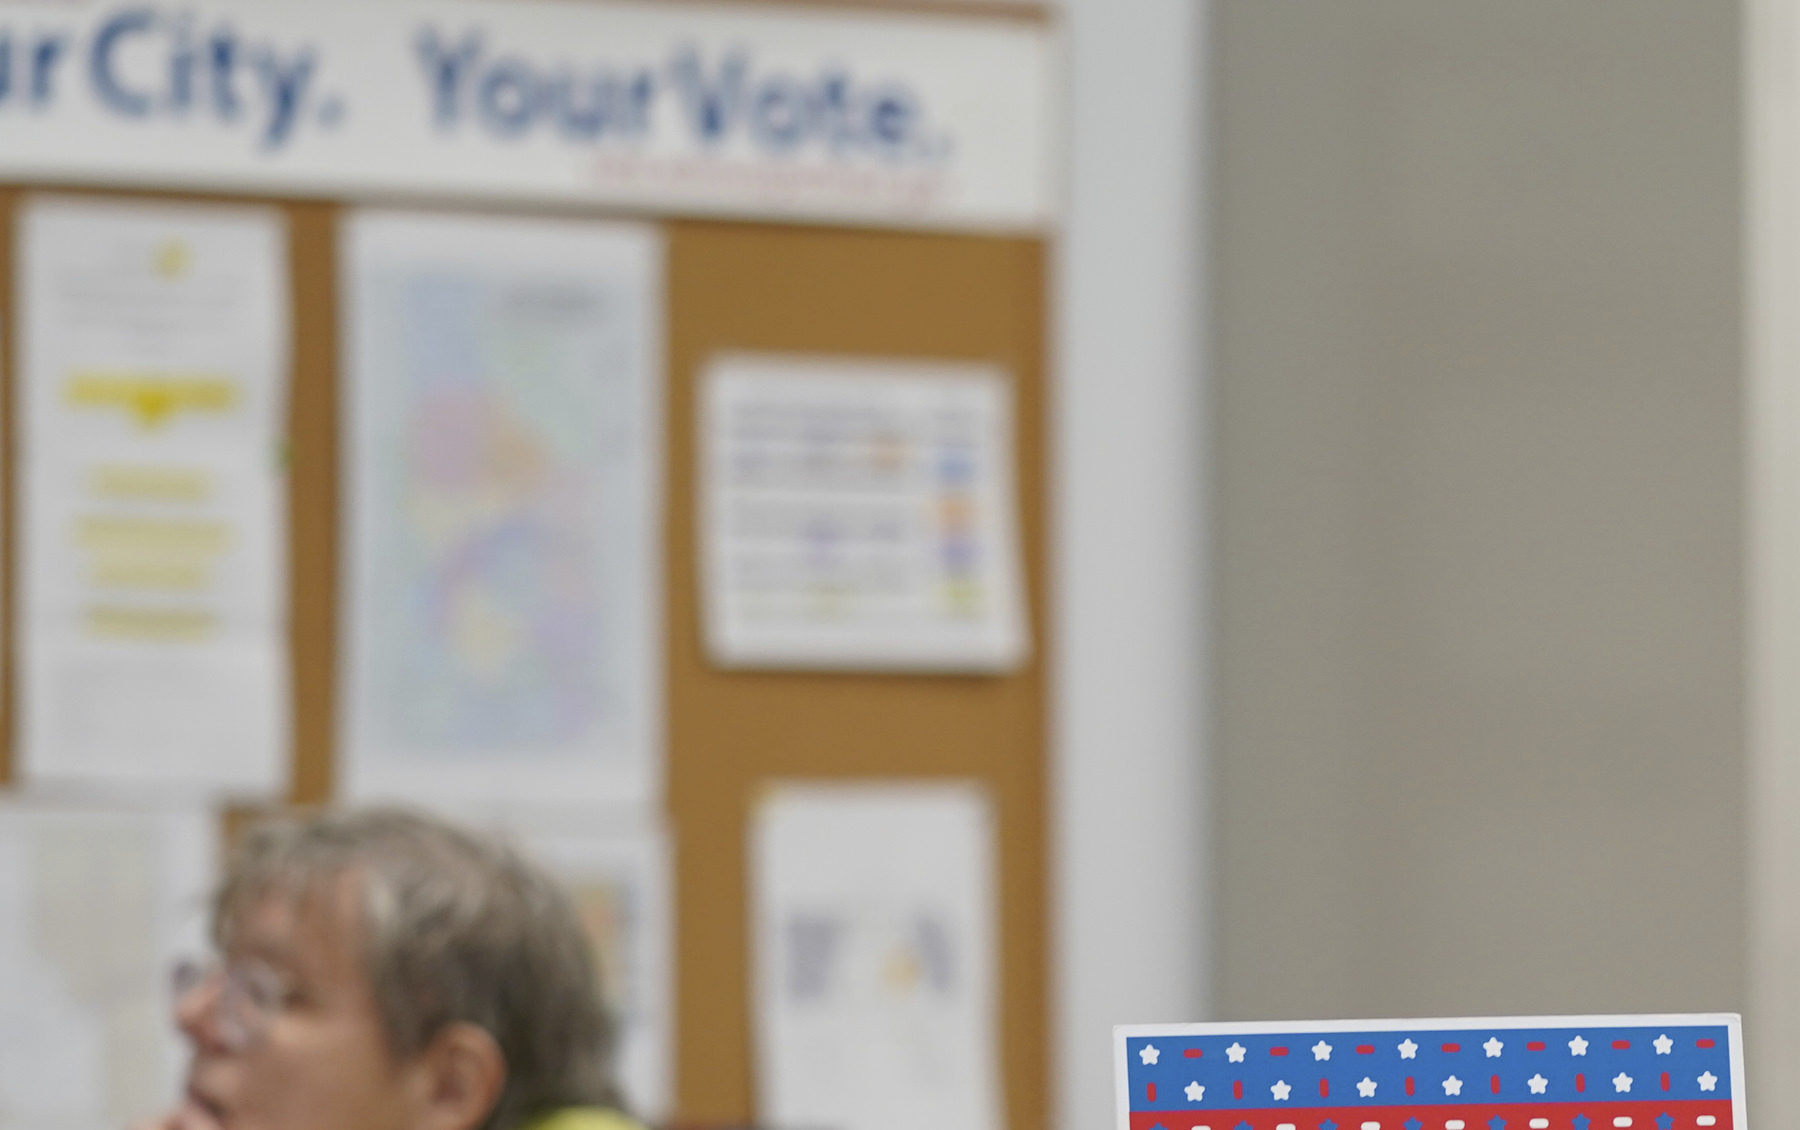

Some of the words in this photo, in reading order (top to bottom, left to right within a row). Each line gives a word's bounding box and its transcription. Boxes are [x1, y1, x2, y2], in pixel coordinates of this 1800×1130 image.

[88, 4, 347, 152] City.
[413, 24, 653, 138] Your
[668, 42, 955, 152] Vote.
